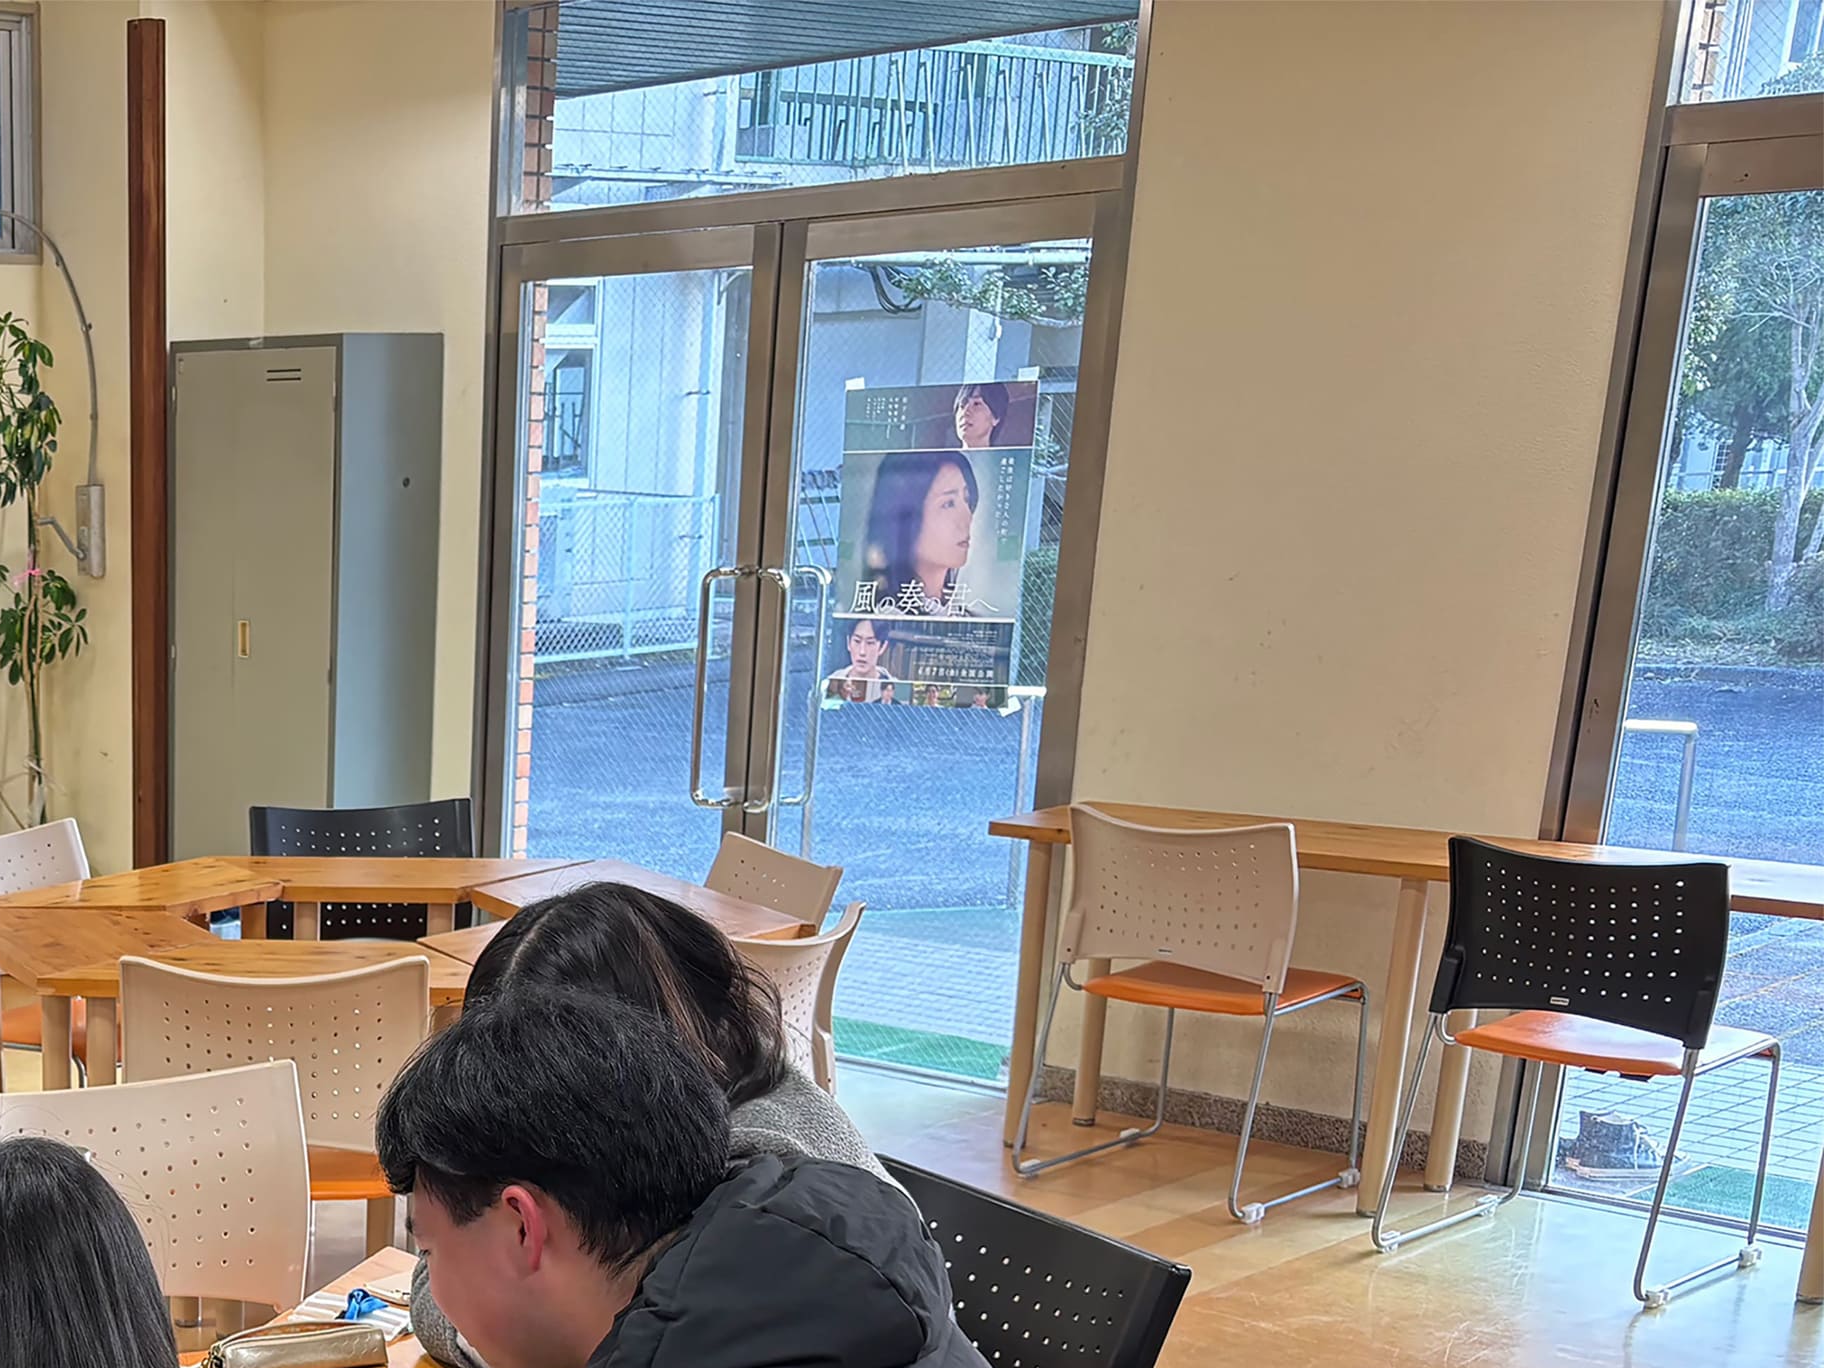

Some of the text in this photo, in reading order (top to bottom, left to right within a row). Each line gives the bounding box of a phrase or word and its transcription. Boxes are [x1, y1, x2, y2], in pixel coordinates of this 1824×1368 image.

[850, 580, 999, 616] 風の奏の君へ
